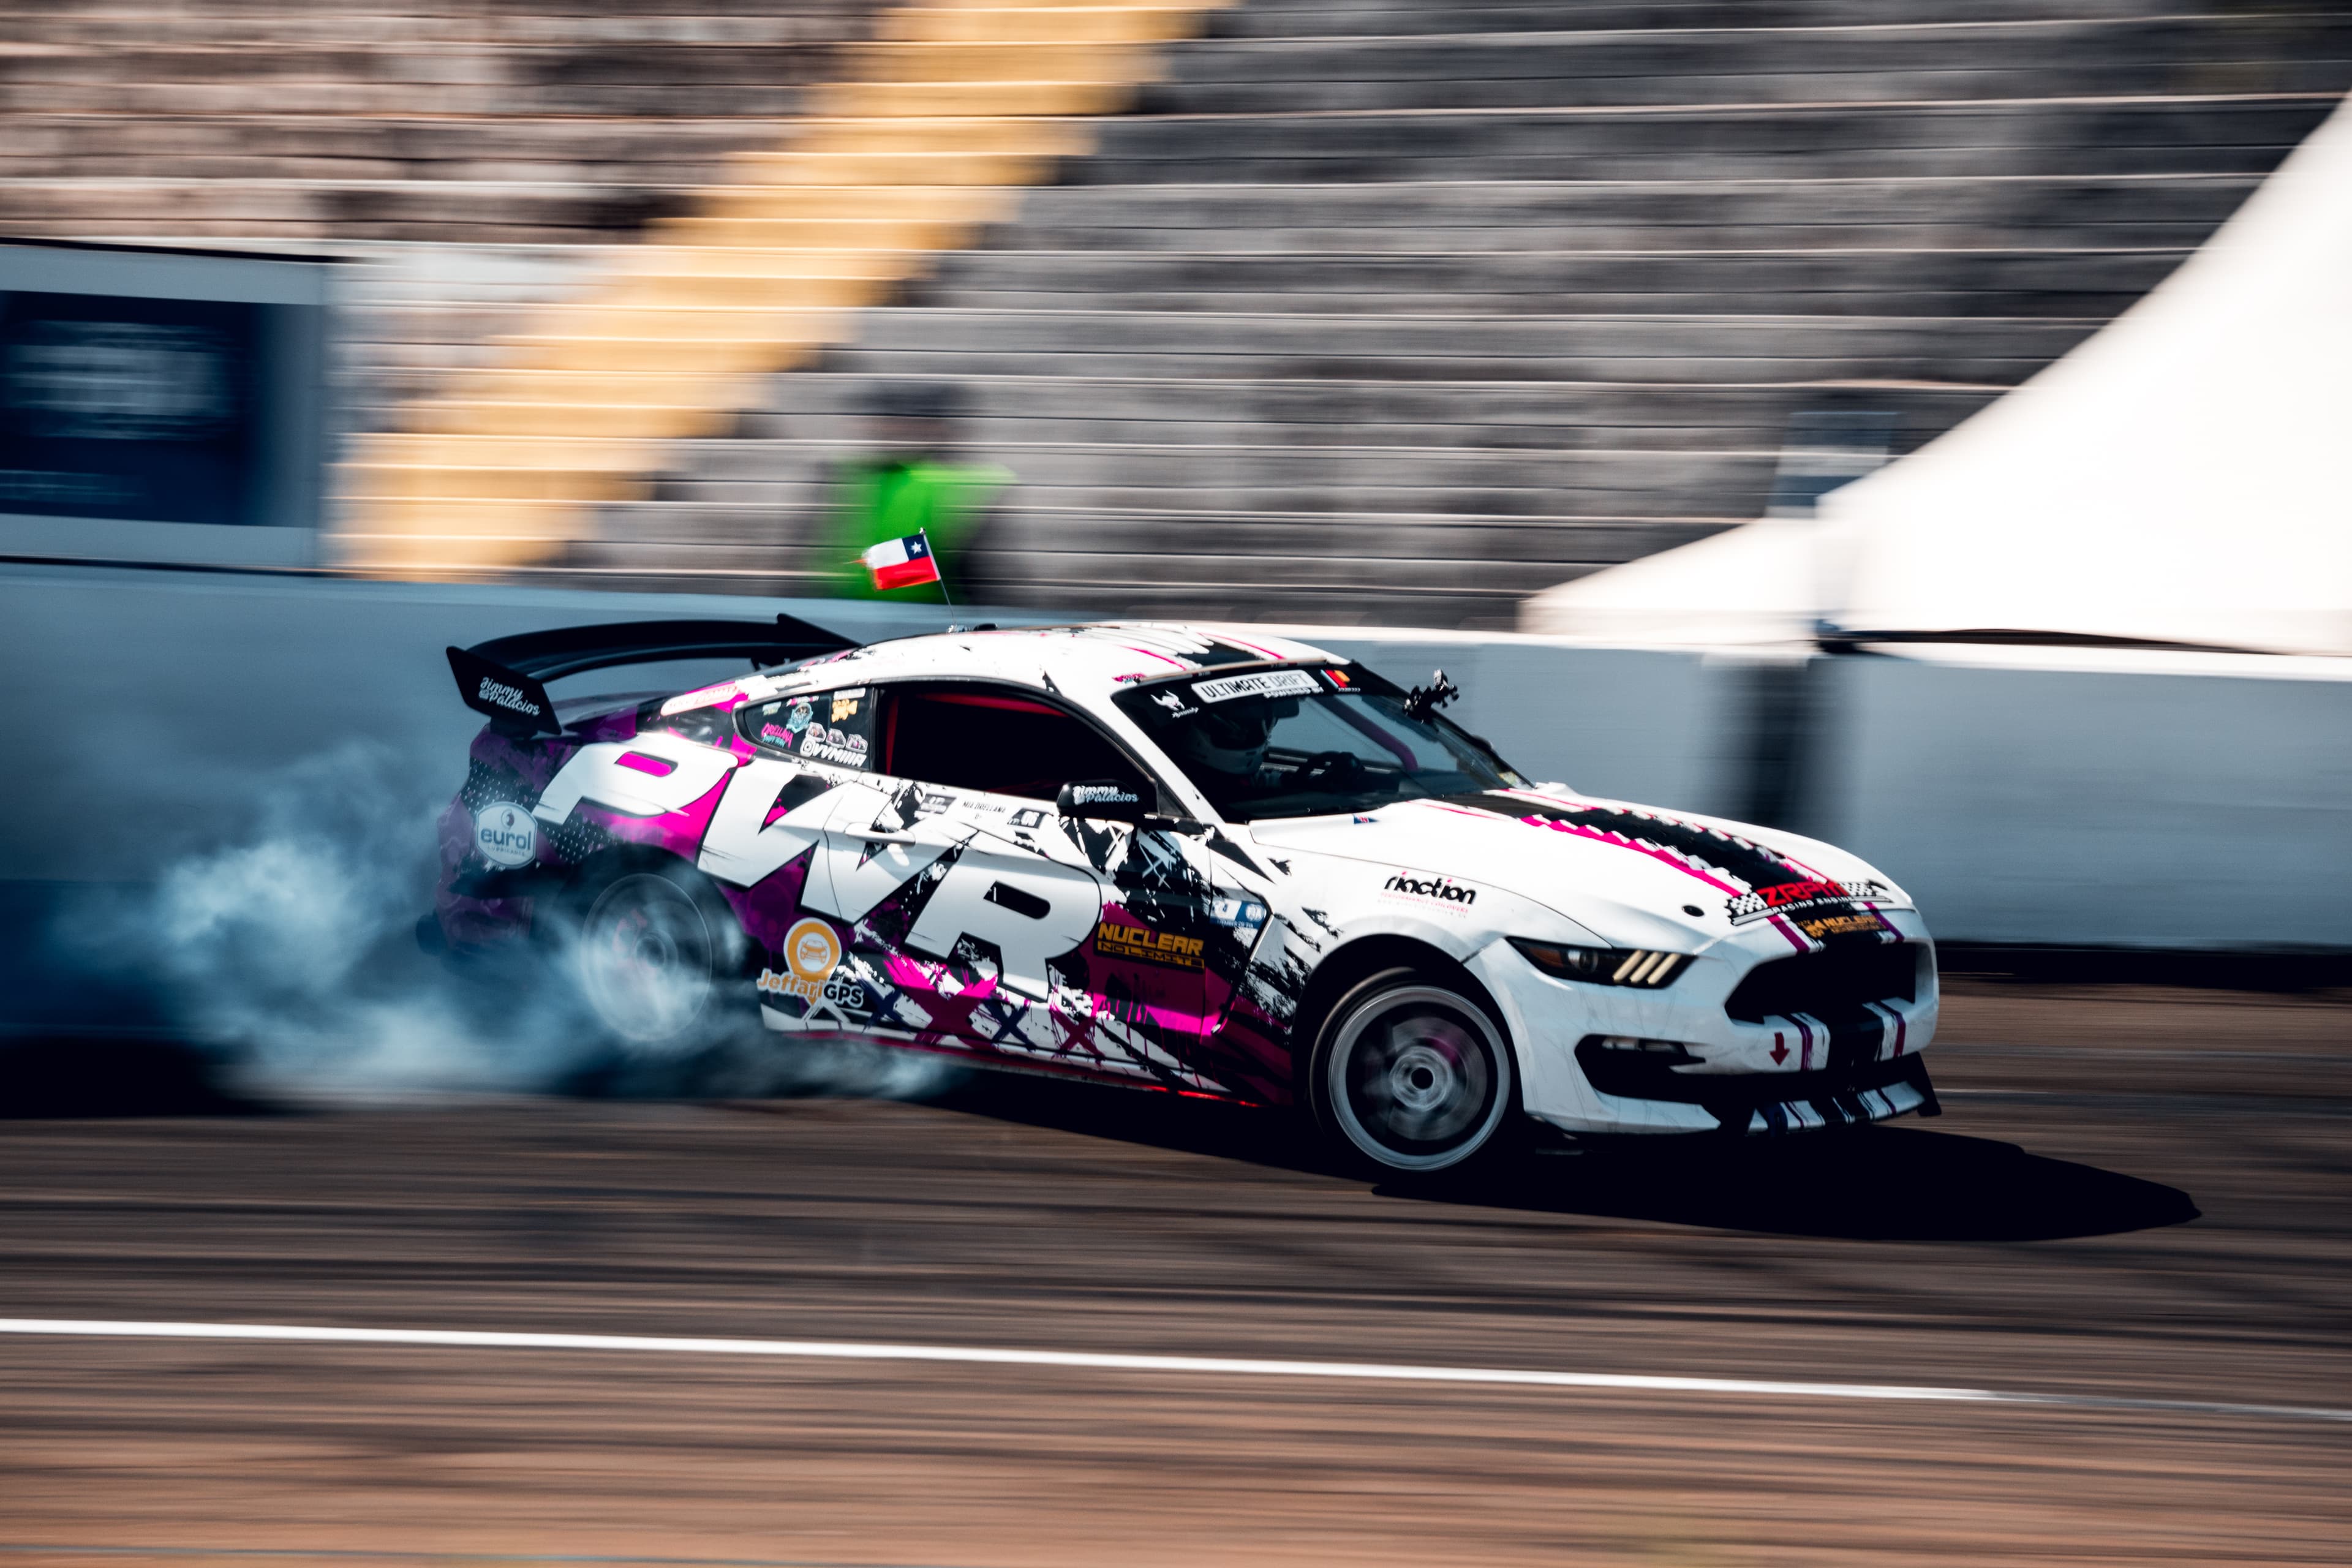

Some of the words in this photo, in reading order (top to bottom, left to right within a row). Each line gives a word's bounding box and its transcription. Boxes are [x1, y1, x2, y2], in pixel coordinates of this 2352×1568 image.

[480, 676, 523, 703] Jimmy
[1200, 677, 1270, 698] ULTIMATE
[1269, 673, 1309, 687] DRIFT
[489, 690, 540, 716] Palacios
[1085, 791, 1139, 803] Palacios
[480, 827, 532, 851] eurol
[1384, 871, 1477, 905] riaction
[1755, 881, 1850, 907] ZRPM
[1771, 898, 1815, 914] RACING
[1098, 922, 1204, 957] NUCLEAR
